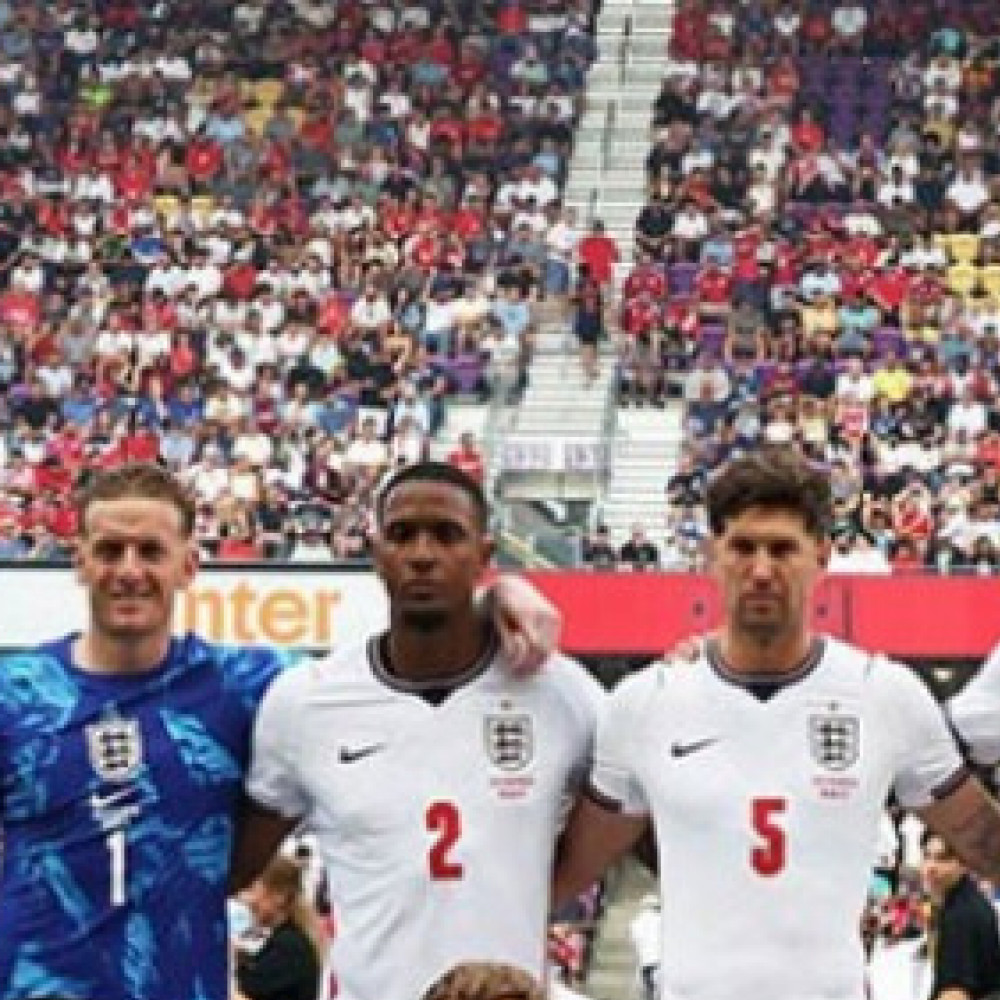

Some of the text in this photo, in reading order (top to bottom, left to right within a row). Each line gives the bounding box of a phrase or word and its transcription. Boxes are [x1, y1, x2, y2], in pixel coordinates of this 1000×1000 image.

[106, 830, 127, 906] 1
[423, 801, 463, 882] 2
[749, 795, 788, 878] 5
